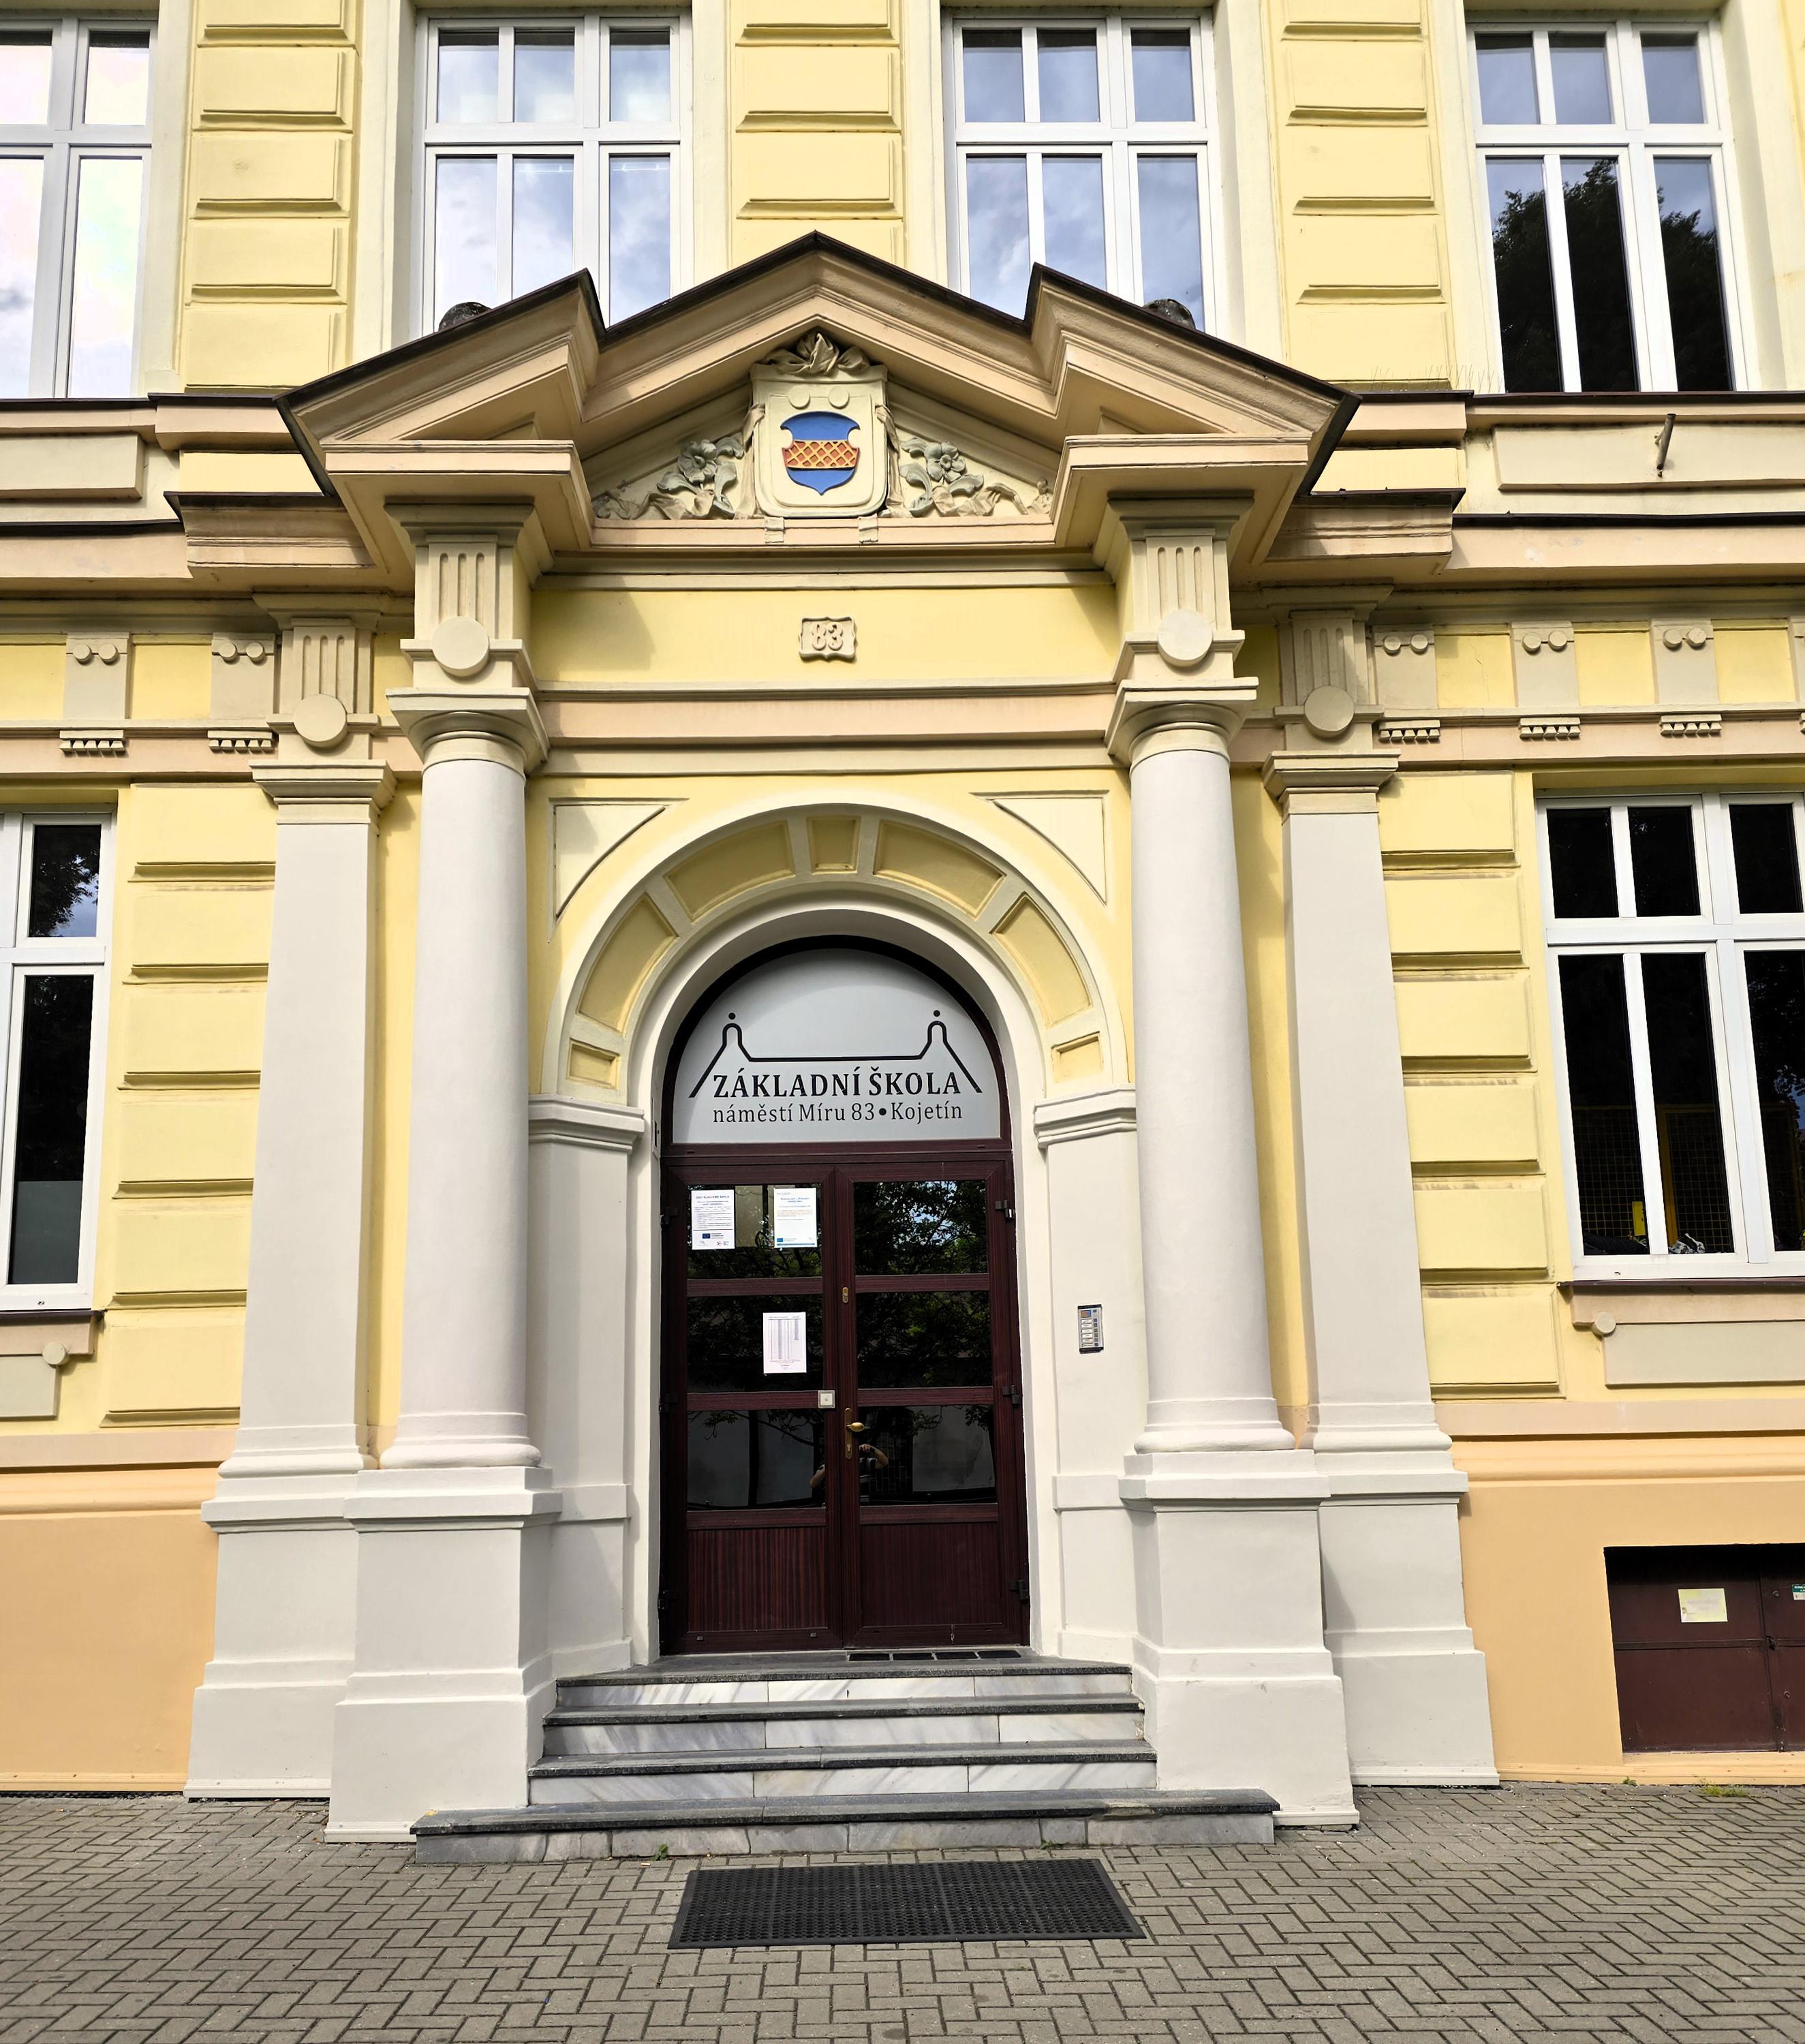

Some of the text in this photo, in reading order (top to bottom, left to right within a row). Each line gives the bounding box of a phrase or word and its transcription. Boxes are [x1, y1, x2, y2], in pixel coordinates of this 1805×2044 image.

[812, 621, 844, 651] 83
[713, 1066, 961, 1098] ZÁKLADNÍ ŠKOLA
[713, 1103, 793, 1123] náměstí
[799, 1102, 846, 1122] Míru
